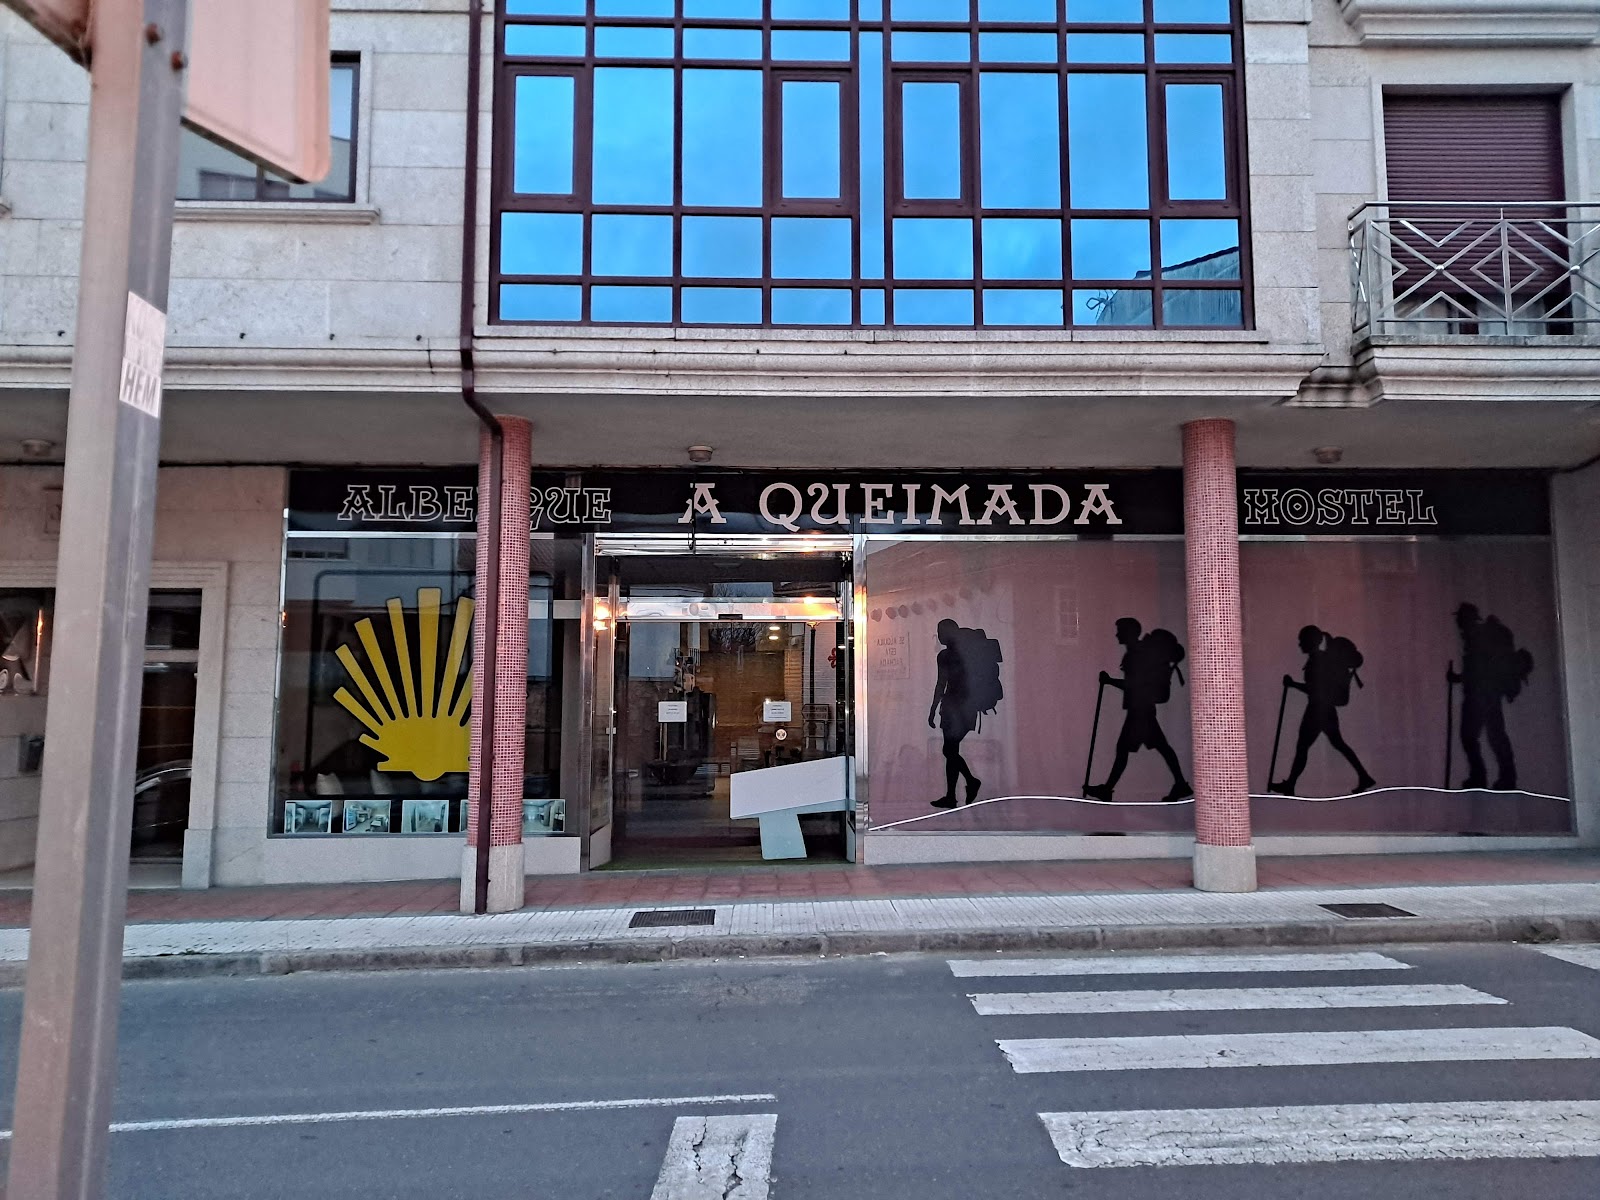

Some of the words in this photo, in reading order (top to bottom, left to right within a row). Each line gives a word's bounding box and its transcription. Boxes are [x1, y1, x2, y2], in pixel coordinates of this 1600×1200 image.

[337, 484, 612, 531] ALBEUE
[678, 482, 727, 525] A
[759, 482, 1123, 533] QUEIMADA
[1243, 488, 1438, 526] HOSTEL
